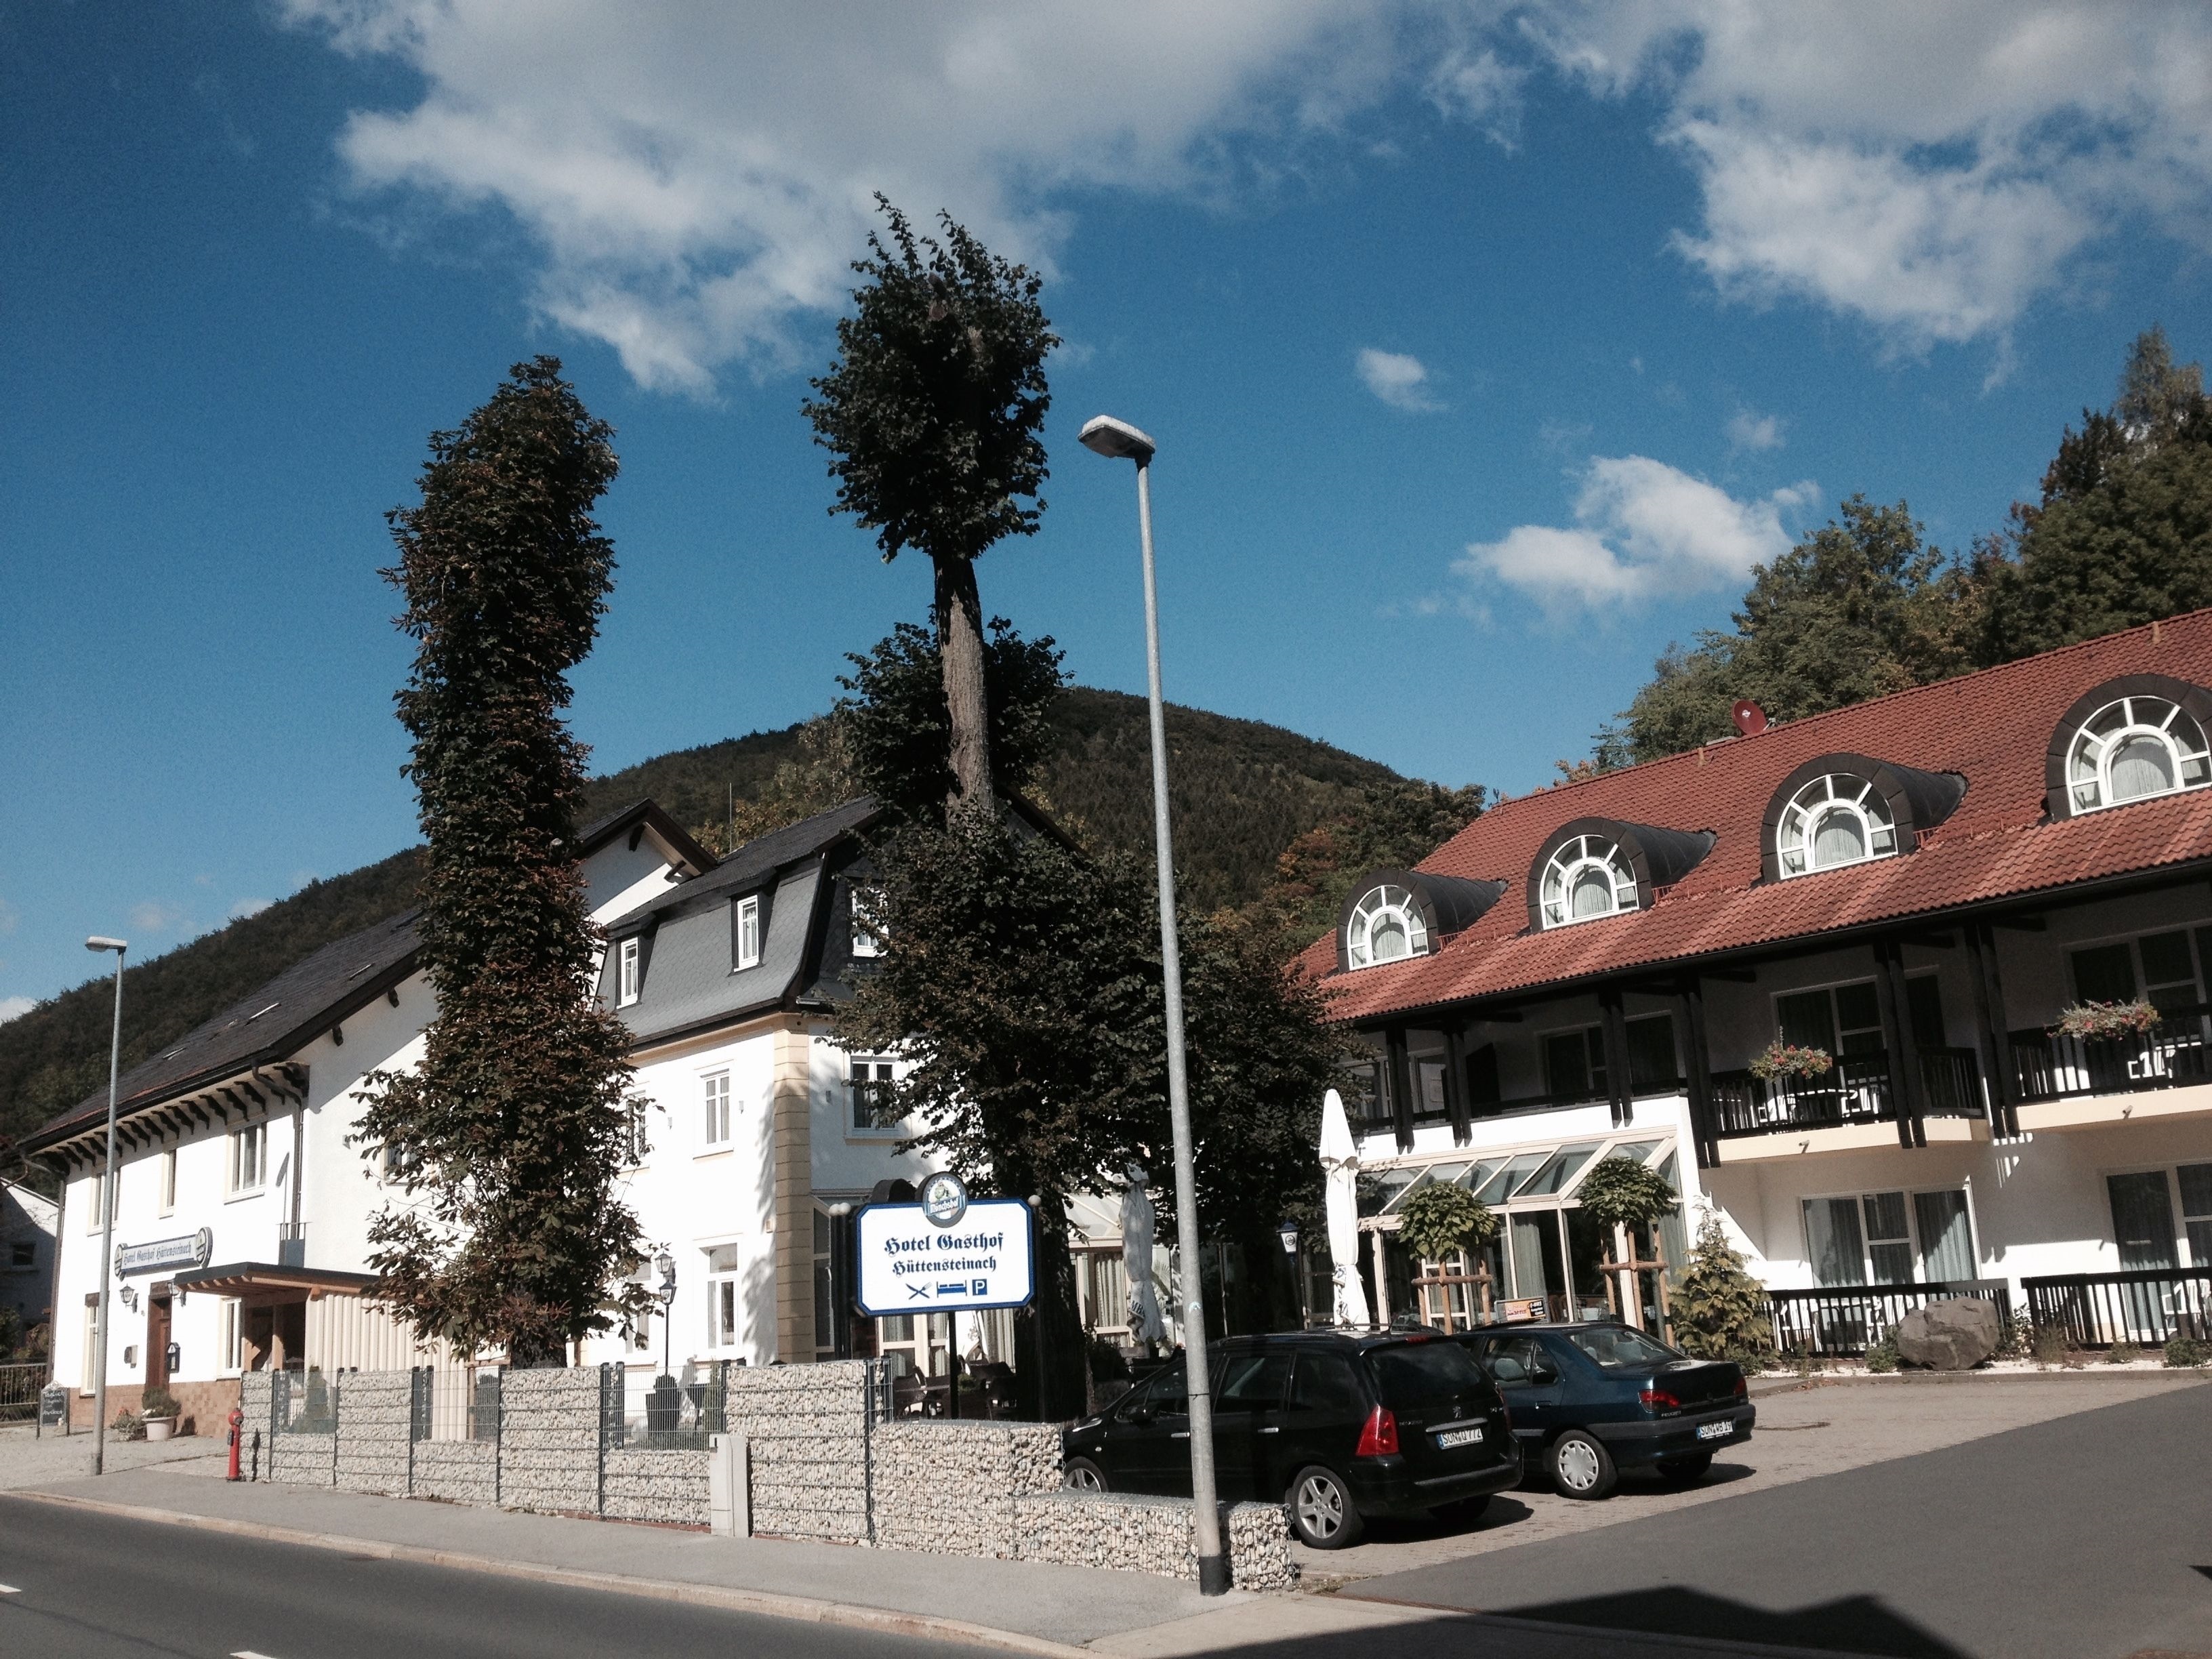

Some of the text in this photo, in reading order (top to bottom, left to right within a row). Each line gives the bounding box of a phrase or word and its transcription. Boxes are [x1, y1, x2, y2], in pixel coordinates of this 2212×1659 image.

[930, 1197, 959, 1214] Mönchshof
[884, 1232, 1004, 1257] Hotel Gasthof
[892, 1256, 997, 1277] Hüttensteinach
